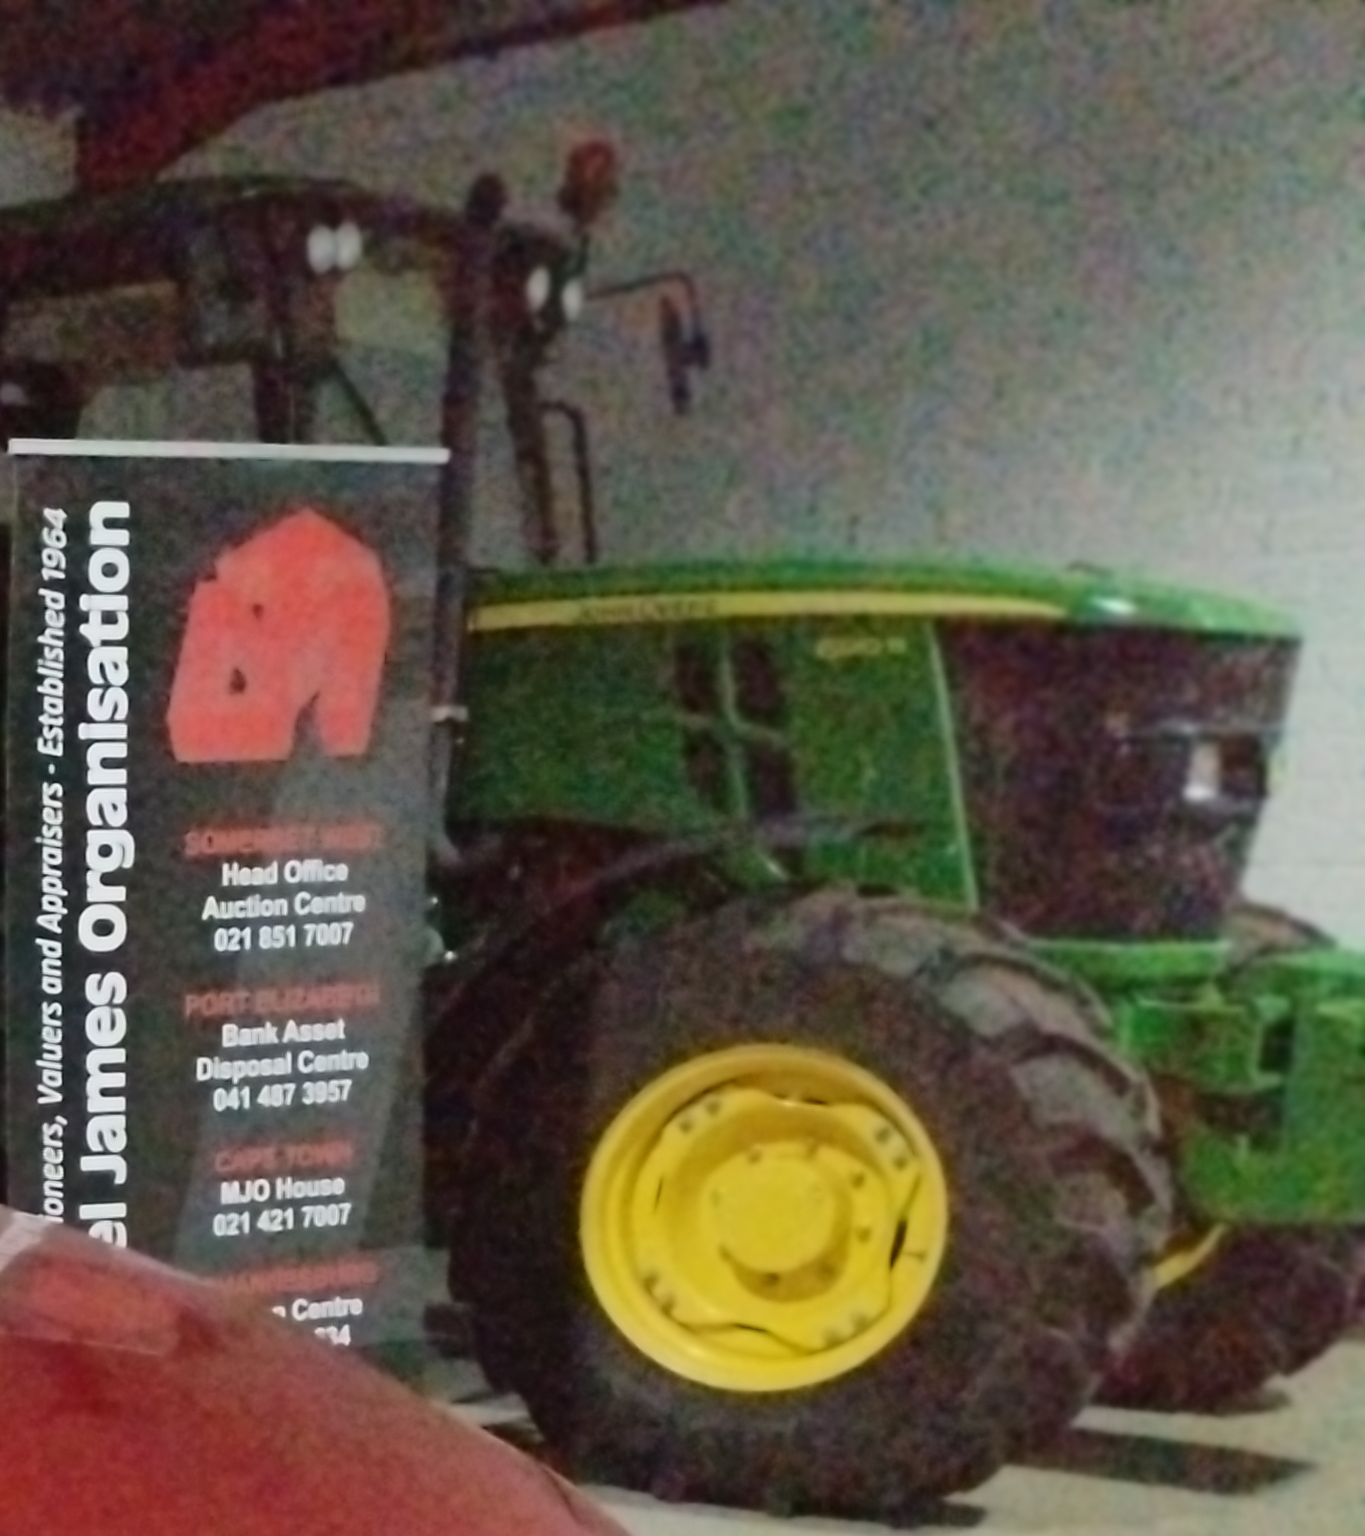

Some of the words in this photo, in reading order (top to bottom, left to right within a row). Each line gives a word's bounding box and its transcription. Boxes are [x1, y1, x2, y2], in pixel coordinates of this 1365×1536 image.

[39, 507, 68, 581] 1964
[36, 588, 65, 758] Established
[78, 501, 135, 953] Organisation
[35, 781, 69, 935] Appraisers
[222, 860, 278, 887] Head
[284, 858, 349, 884] Office
[202, 893, 288, 921] Auction
[294, 890, 368, 917] Centre
[214, 925, 252, 952] 021
[258, 923, 297, 949] 851
[303, 920, 355, 947] 7007
[35, 938, 63, 995] and
[222, 1020, 279, 1048] Bank
[282, 1016, 346, 1044] Asset
[36, 1001, 64, 1105] Valuers
[196, 1051, 292, 1083] Disposal
[298, 1048, 369, 1075] Centre
[79, 971, 127, 1185] James
[213, 1085, 250, 1112] 041
[39, 1115, 68, 1224] ioneers,
[221, 1178, 270, 1205] MJO
[276, 1175, 346, 1201] House
[213, 1210, 250, 1237] 021
[257, 1206, 295, 1232] 421
[301, 1202, 352, 1230] 7007
[291, 1296, 364, 1321] Centre
